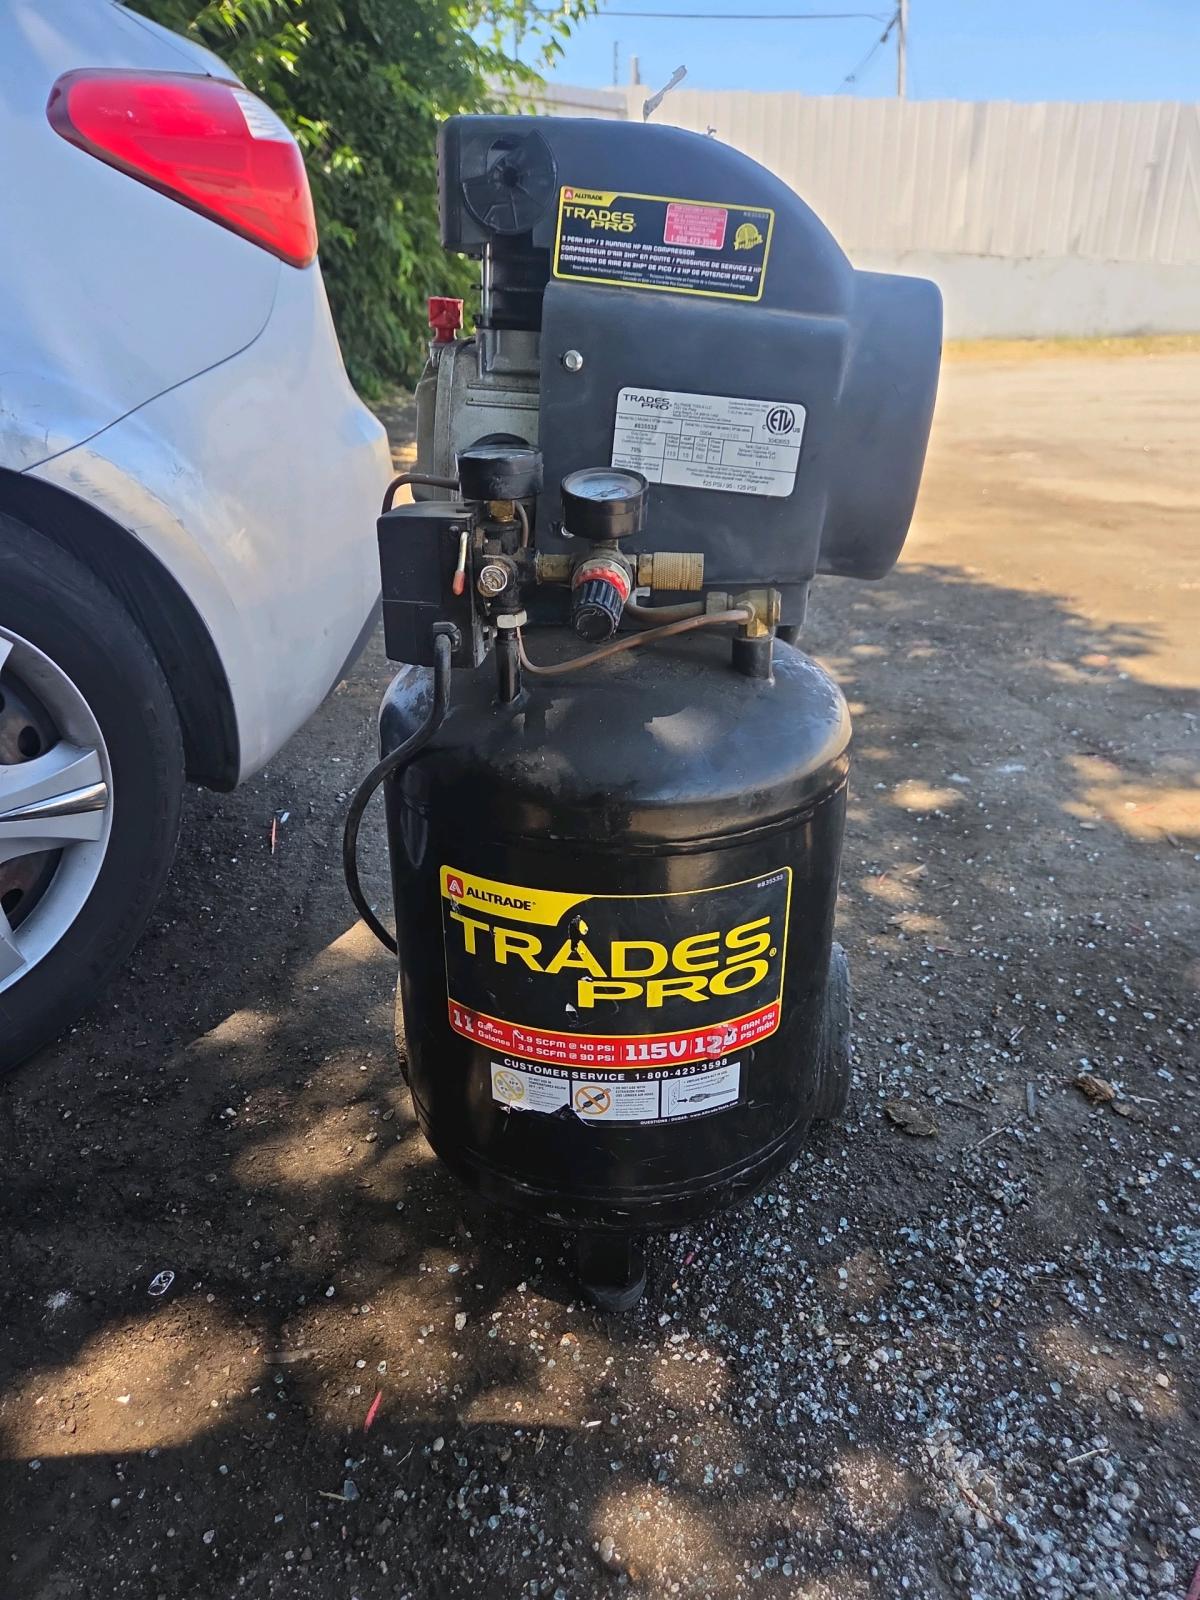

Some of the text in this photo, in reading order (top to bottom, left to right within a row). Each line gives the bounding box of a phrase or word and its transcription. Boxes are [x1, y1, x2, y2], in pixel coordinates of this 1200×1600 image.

[574, 192, 602, 201] ALLTRADE
[564, 206, 634, 224] TRADES
[591, 220, 634, 232] PRO
[606, 240, 631, 249] RUNNING
[654, 244, 695, 256] COMPRESSOR
[561, 245, 605, 255] COMPRESSEUR
[649, 254, 670, 263] POINTE
[676, 258, 710, 267] PUISSANCE
[721, 262, 746, 272] SERVICE
[560, 254, 597, 264] COMPRESOR
[658, 264, 672, 272] PICO
[701, 270, 731, 280] POTENCIA
[732, 273, 754, 282] EFICAZ
[623, 394, 670, 405] TRADES
[642, 402, 669, 411] PRO
[466, 887, 532, 911] ALLTRADE
[450, 911, 771, 978] TRADES
[576, 960, 769, 1008] PRO
[762, 1011, 775, 1023] PSI
[478, 1030, 511, 1047] Galones
[535, 1037, 566, 1049] SCFM
[569, 1041, 577, 1050] @
[740, 1030, 755, 1041] PSI
[518, 1044, 615, 1062] 3.8 SCFM @ 90 PSI
[626, 1039, 688, 1061] 115V
[504, 1058, 728, 1081] CUSTOMER SERVICE 1-800-423-3598
